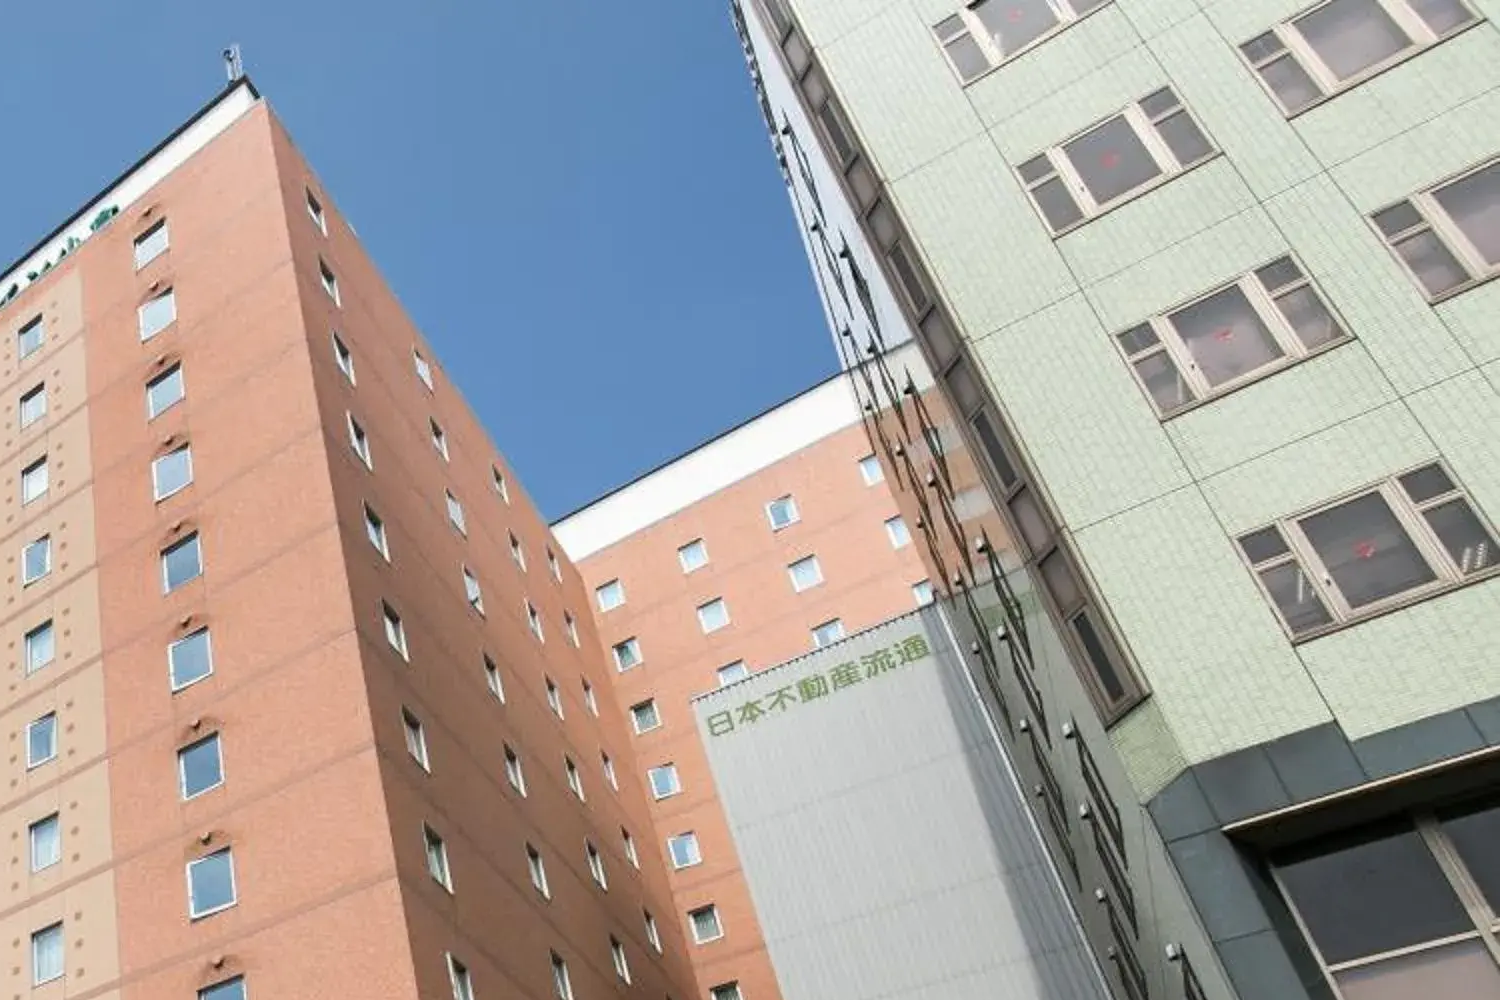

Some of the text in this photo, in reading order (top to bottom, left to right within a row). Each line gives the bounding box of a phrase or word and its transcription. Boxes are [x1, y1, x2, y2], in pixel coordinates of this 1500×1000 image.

[707, 634, 930, 736] 日本不動産流通
